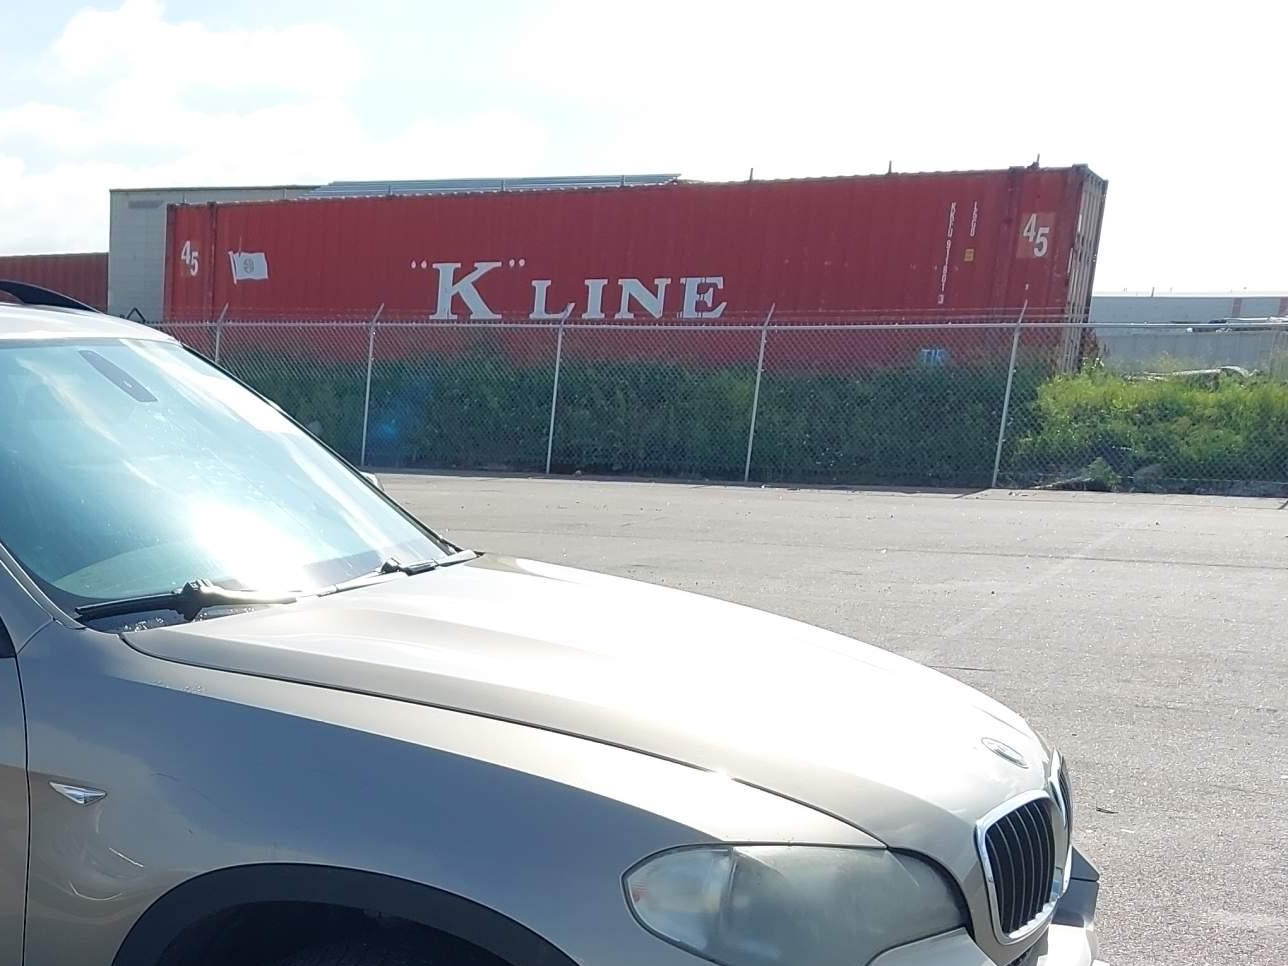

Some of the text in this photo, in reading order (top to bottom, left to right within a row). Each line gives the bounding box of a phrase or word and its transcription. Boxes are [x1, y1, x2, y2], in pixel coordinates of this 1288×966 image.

[1022, 213, 1050, 256] 45
[180, 239, 199, 276] 45
[529, 276, 728, 320] LINE
